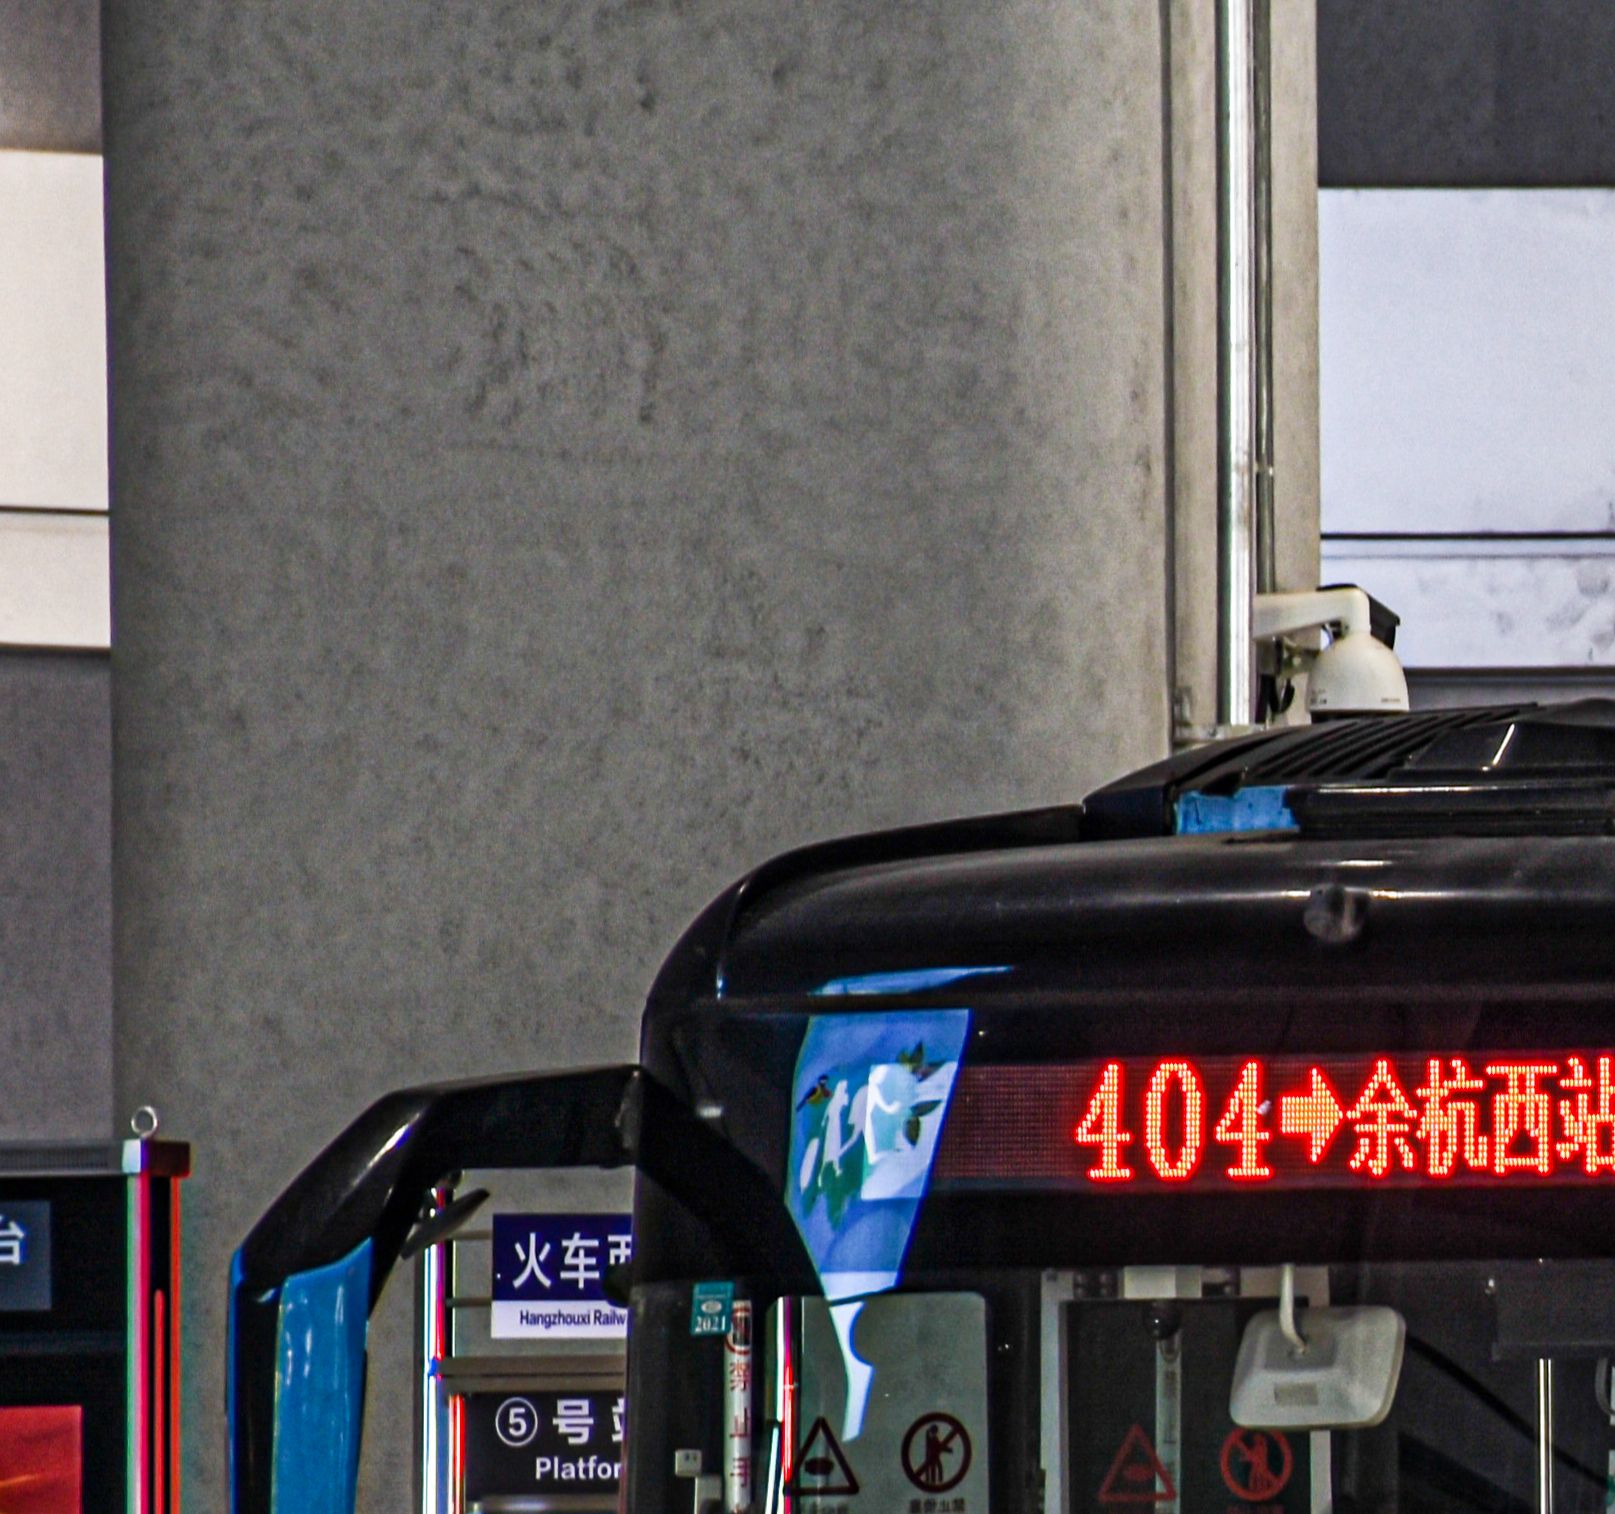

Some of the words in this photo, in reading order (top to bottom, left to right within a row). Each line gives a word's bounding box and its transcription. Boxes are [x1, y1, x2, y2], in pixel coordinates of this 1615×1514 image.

[1075, 1060, 1272, 1180] 404
[520, 1310, 591, 1329] Hangzhouxi
[694, 1315, 726, 1334] 2021
